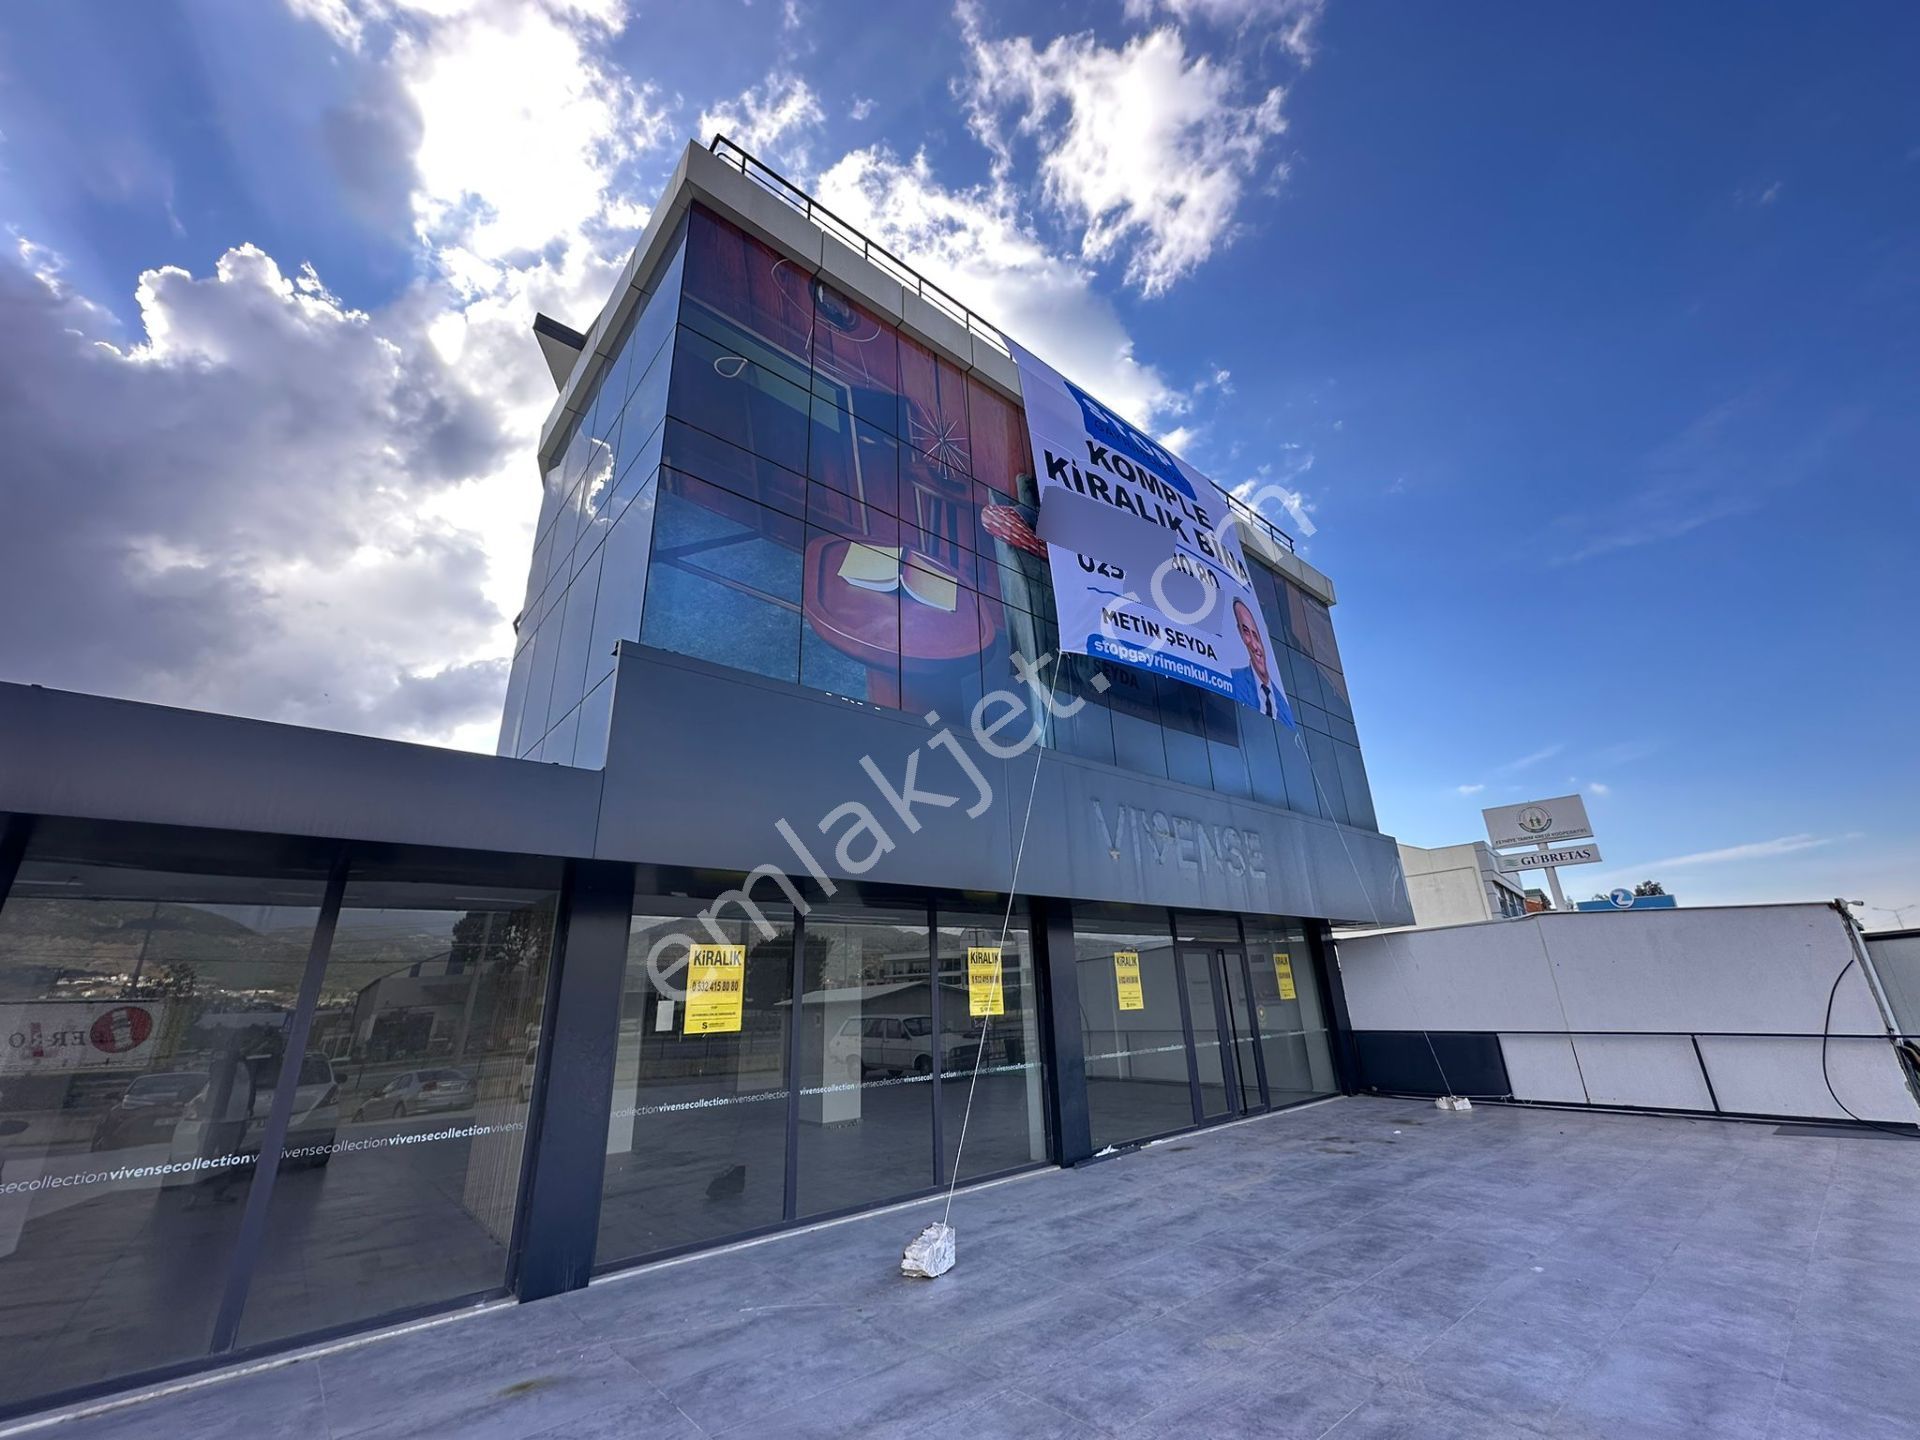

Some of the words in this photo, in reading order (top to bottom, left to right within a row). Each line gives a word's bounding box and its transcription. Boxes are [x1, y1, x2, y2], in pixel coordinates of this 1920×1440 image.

[1085, 440, 1214, 531] KOMPLE
[1044, 449, 1191, 545] KİRALIK
[1193, 528, 1252, 588] BİNA
[1101, 606, 1161, 639] METİN
[1165, 627, 1218, 661] ŞEYDA
[1094, 638, 1233, 694] stopgayrimenkul.com
[709, 981, 721, 992] 415
[722, 981, 730, 992] 80
[731, 981, 739, 992] 80
[659, 1096, 729, 1112] vivensecollection
[109, 1152, 250, 1180] vivensecollection
[388, 1123, 491, 1146] vivensecollection
